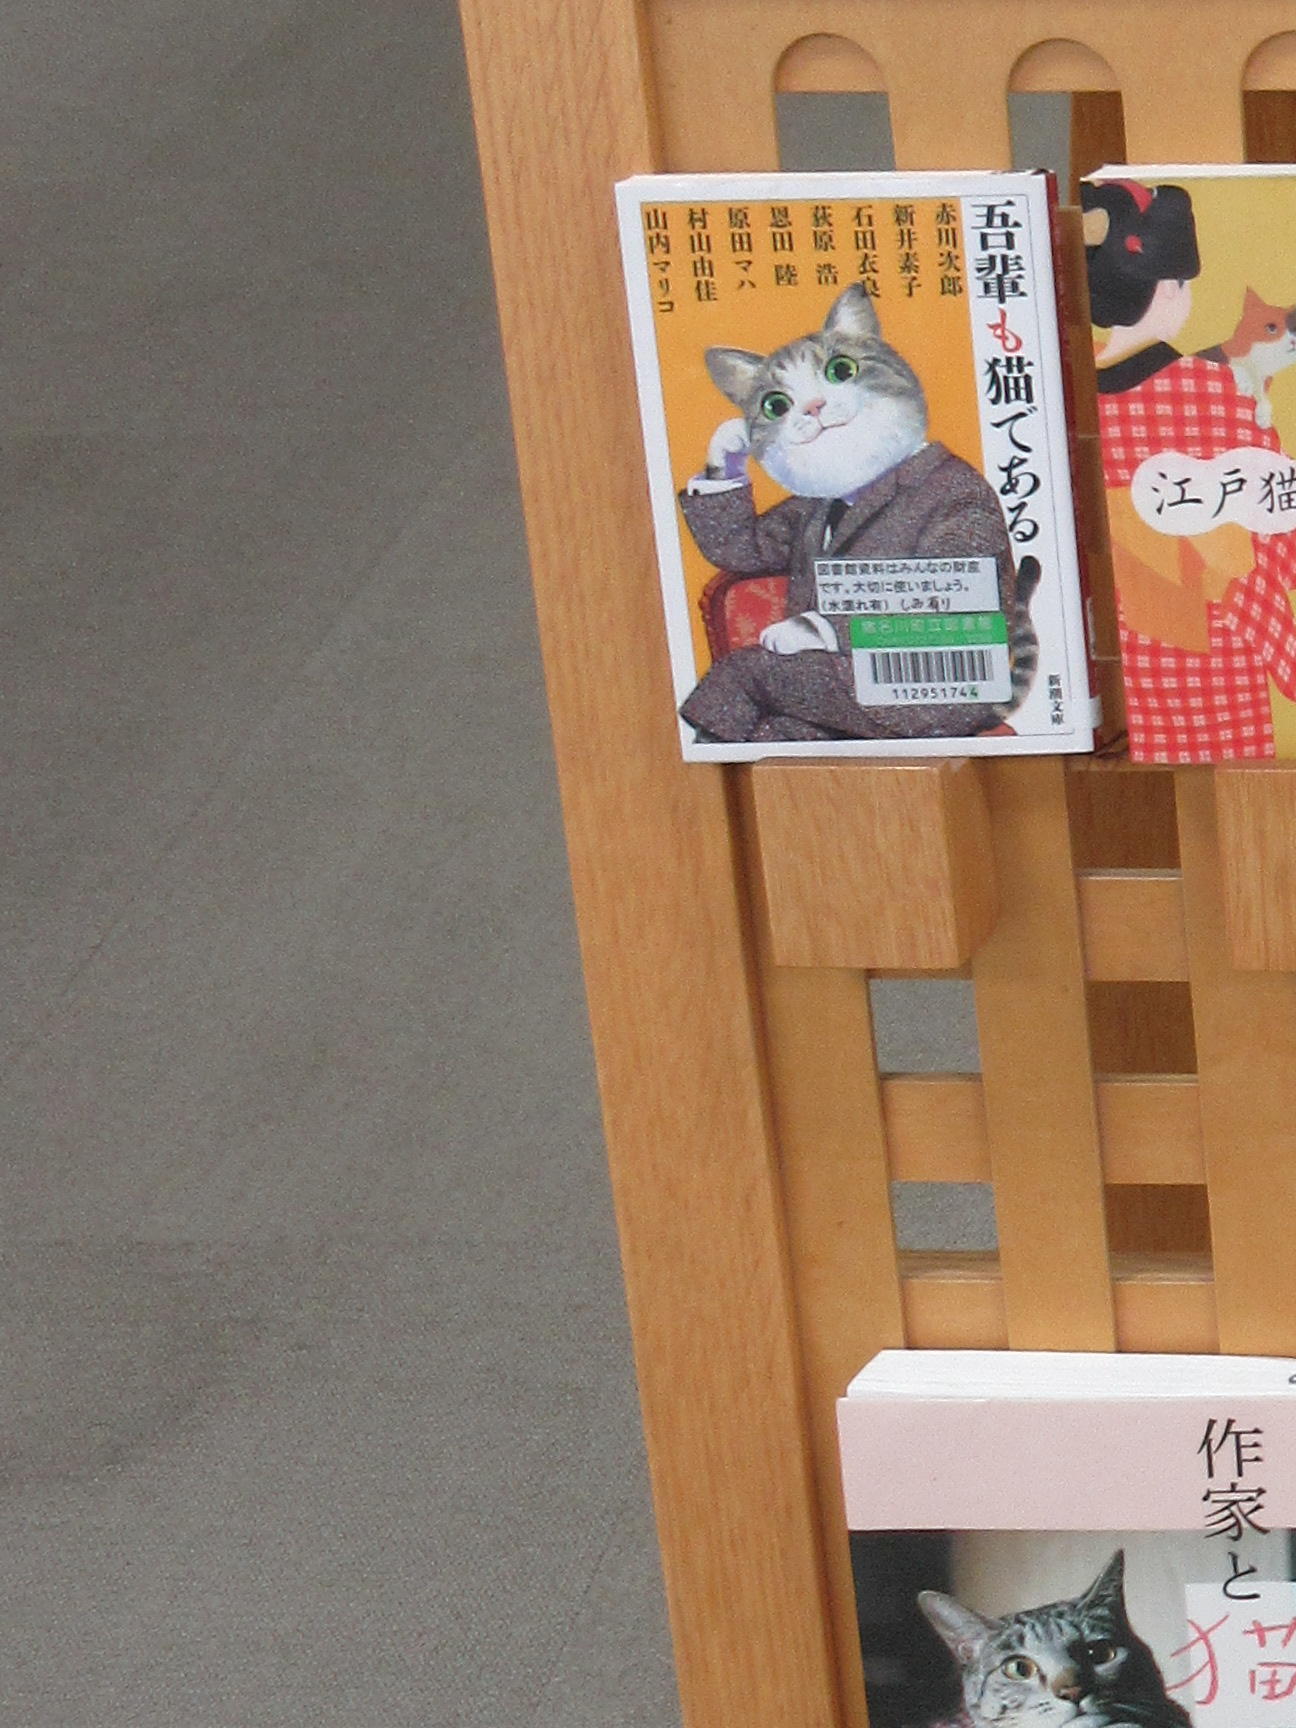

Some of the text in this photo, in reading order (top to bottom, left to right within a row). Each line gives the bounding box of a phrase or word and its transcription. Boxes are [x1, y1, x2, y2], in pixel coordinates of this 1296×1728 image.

[645, 208, 675, 314] 山内マリコ
[688, 206, 718, 302] 村山由佳
[728, 206, 756, 291] 原田マハ
[853, 205, 881, 299] 石田衣良
[893, 204, 922, 298] 新井素子
[935, 204, 963, 298] 赤川次郎
[970, 199, 1043, 544] 吾輩も猫である
[893, 687, 979, 700] 112951744
[1047, 673, 1065, 725] 新潮文庫
